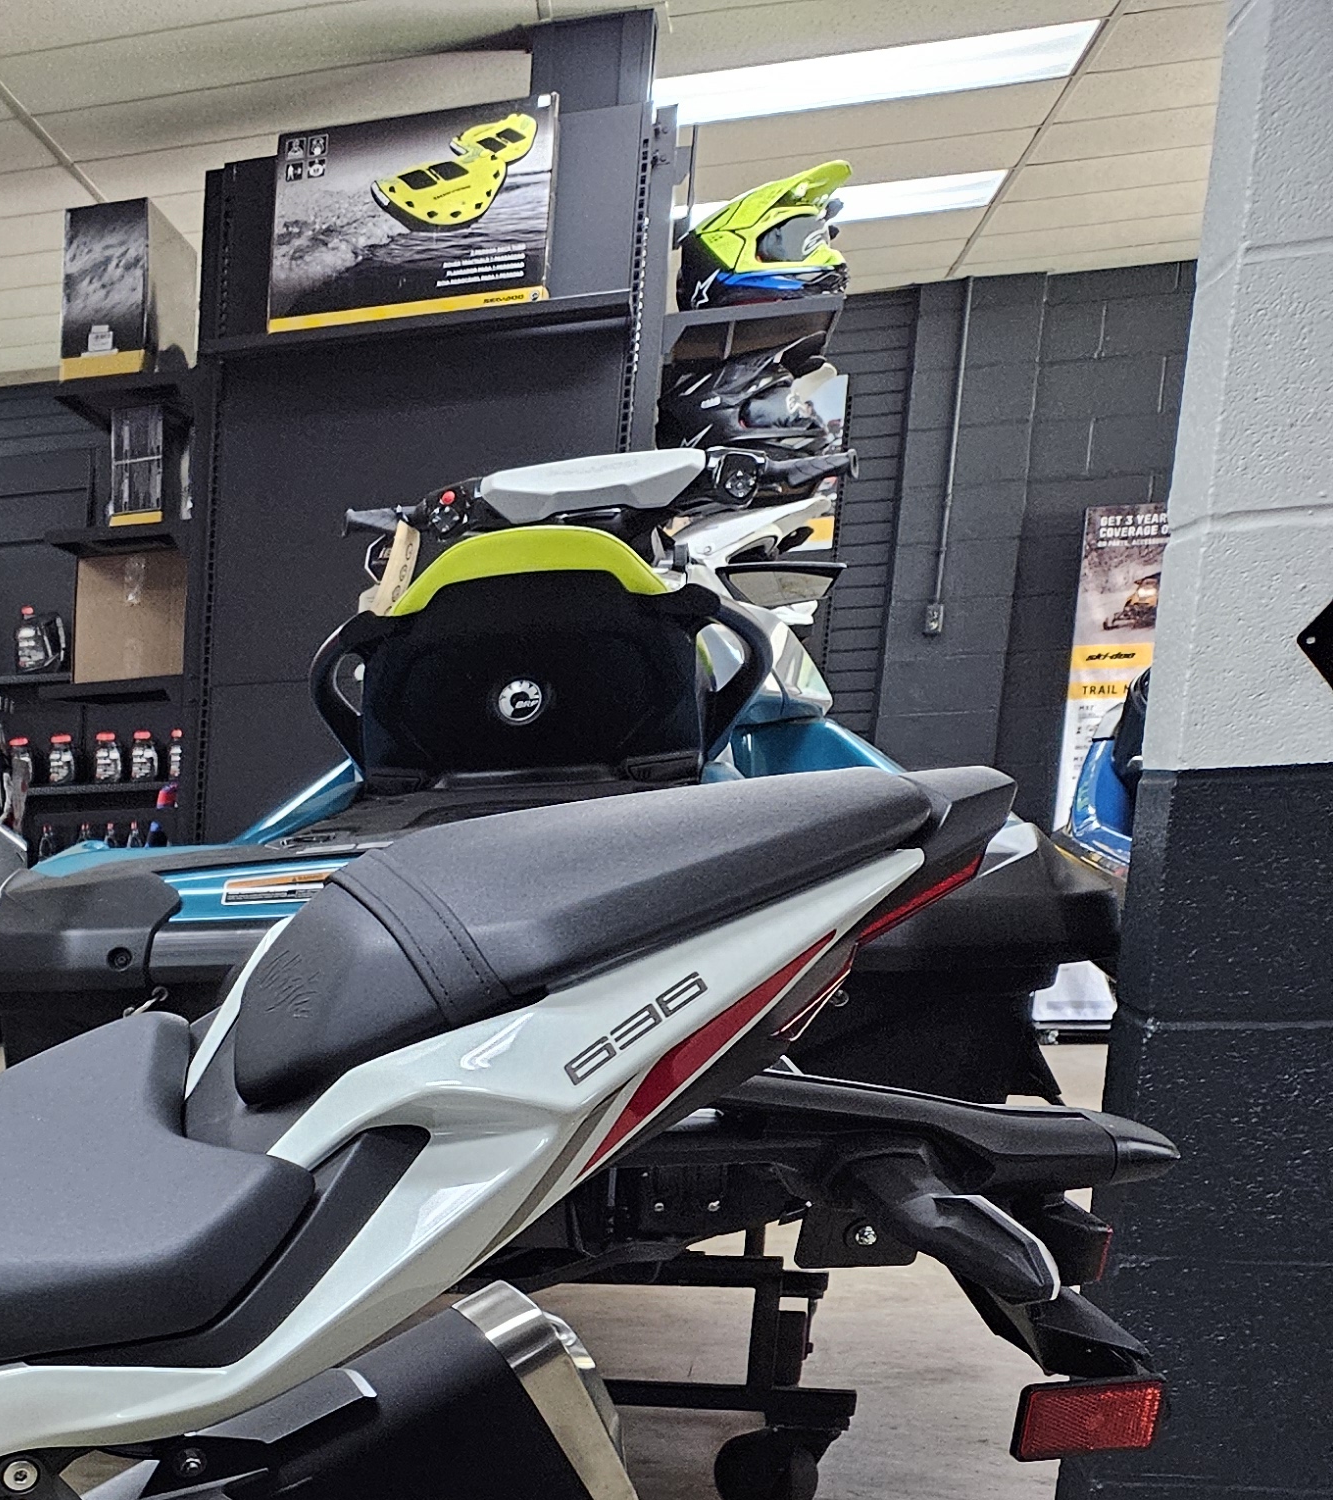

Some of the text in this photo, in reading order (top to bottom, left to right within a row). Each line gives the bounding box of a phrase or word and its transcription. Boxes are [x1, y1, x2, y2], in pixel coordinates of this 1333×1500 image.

[1099, 525, 1159, 538] COVERAGE
[1082, 684, 1119, 696] TRAIL
[564, 971, 708, 1086] 636
